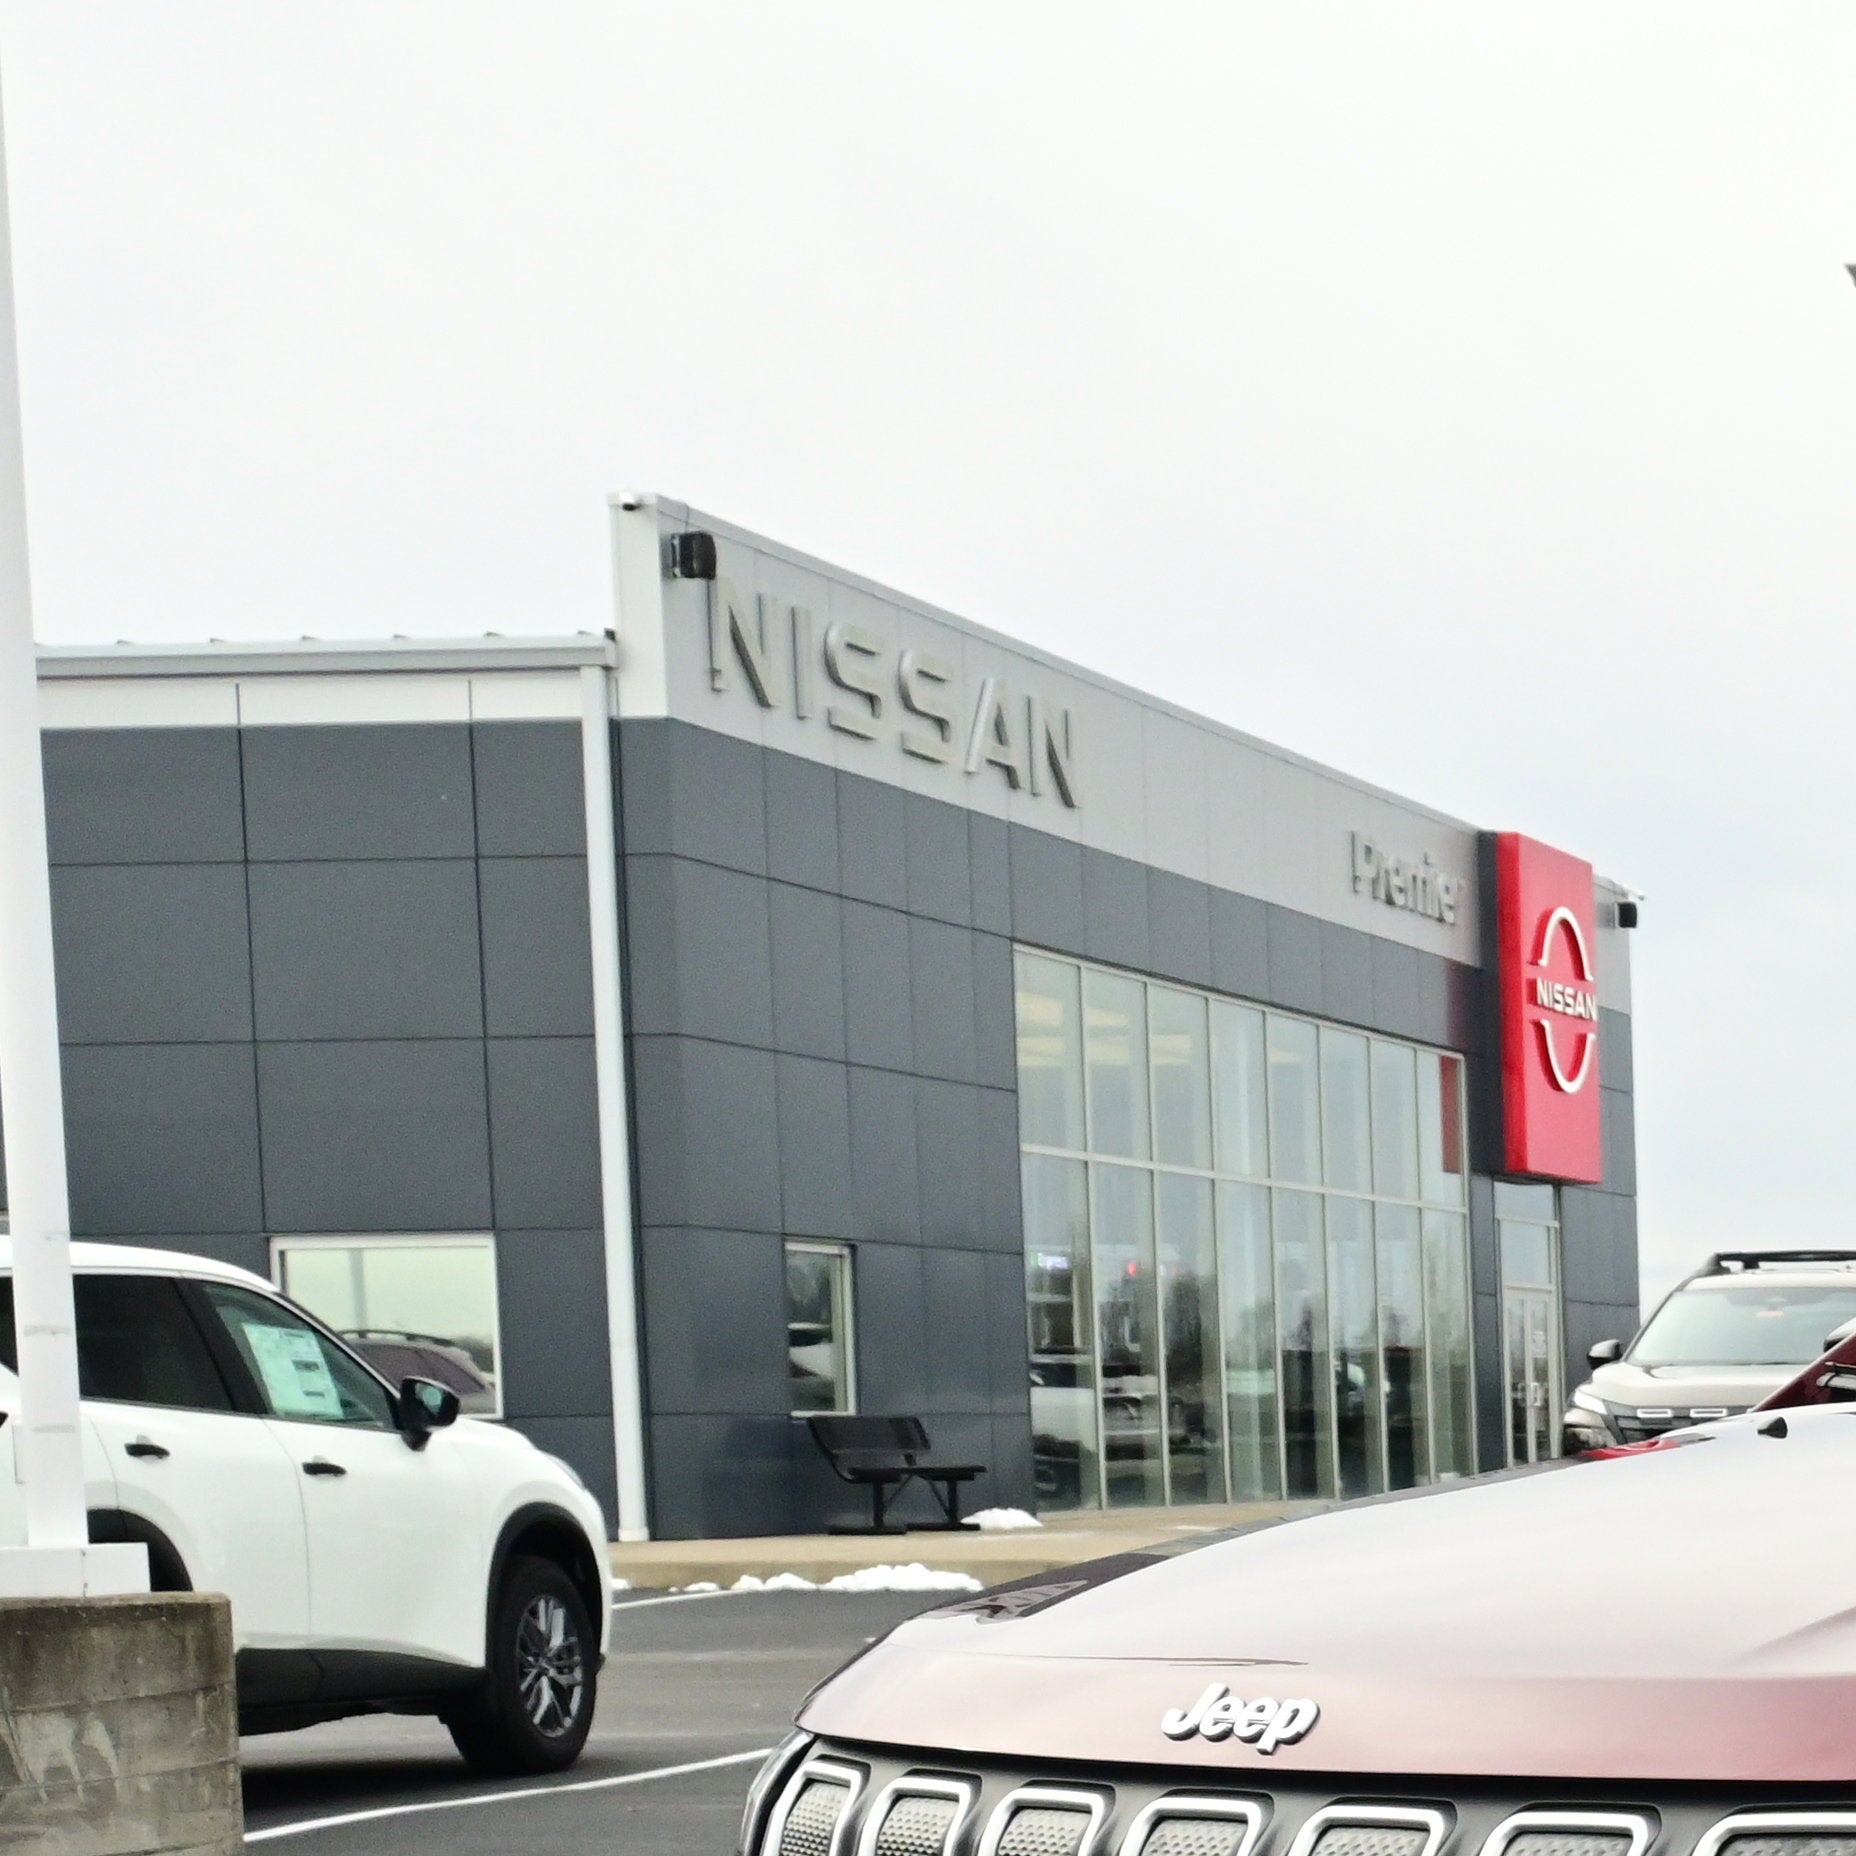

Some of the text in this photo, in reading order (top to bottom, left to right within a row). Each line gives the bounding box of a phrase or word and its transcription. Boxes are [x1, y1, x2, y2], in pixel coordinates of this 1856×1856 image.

[706, 577, 1080, 808] NISSAN
[1536, 976, 1598, 1022] NISSAN
[1161, 1682, 1321, 1756] Jeep
